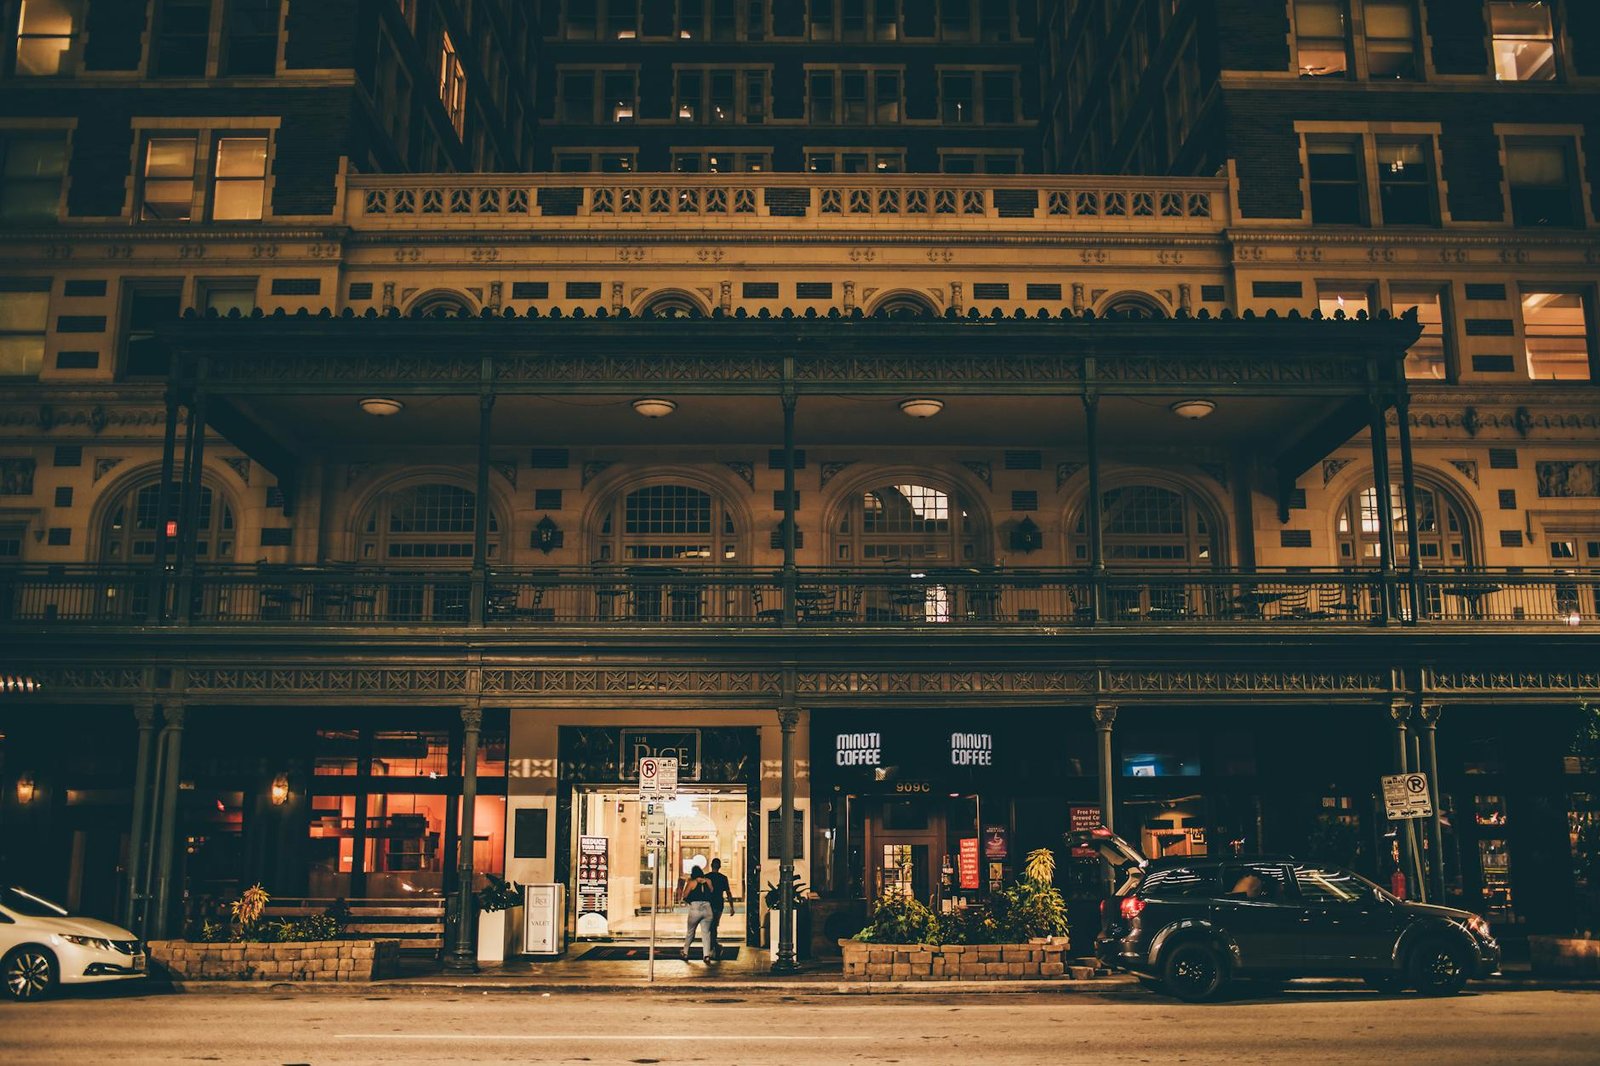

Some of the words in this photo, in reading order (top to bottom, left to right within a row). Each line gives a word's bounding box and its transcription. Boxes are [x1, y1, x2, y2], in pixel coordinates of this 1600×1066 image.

[836, 732, 880, 749] MINUTI
[951, 732, 991, 749] MINUTI
[836, 749, 880, 766] COFFEE
[951, 749, 991, 766] COFFEE
[896, 783, 930, 792] 909C
